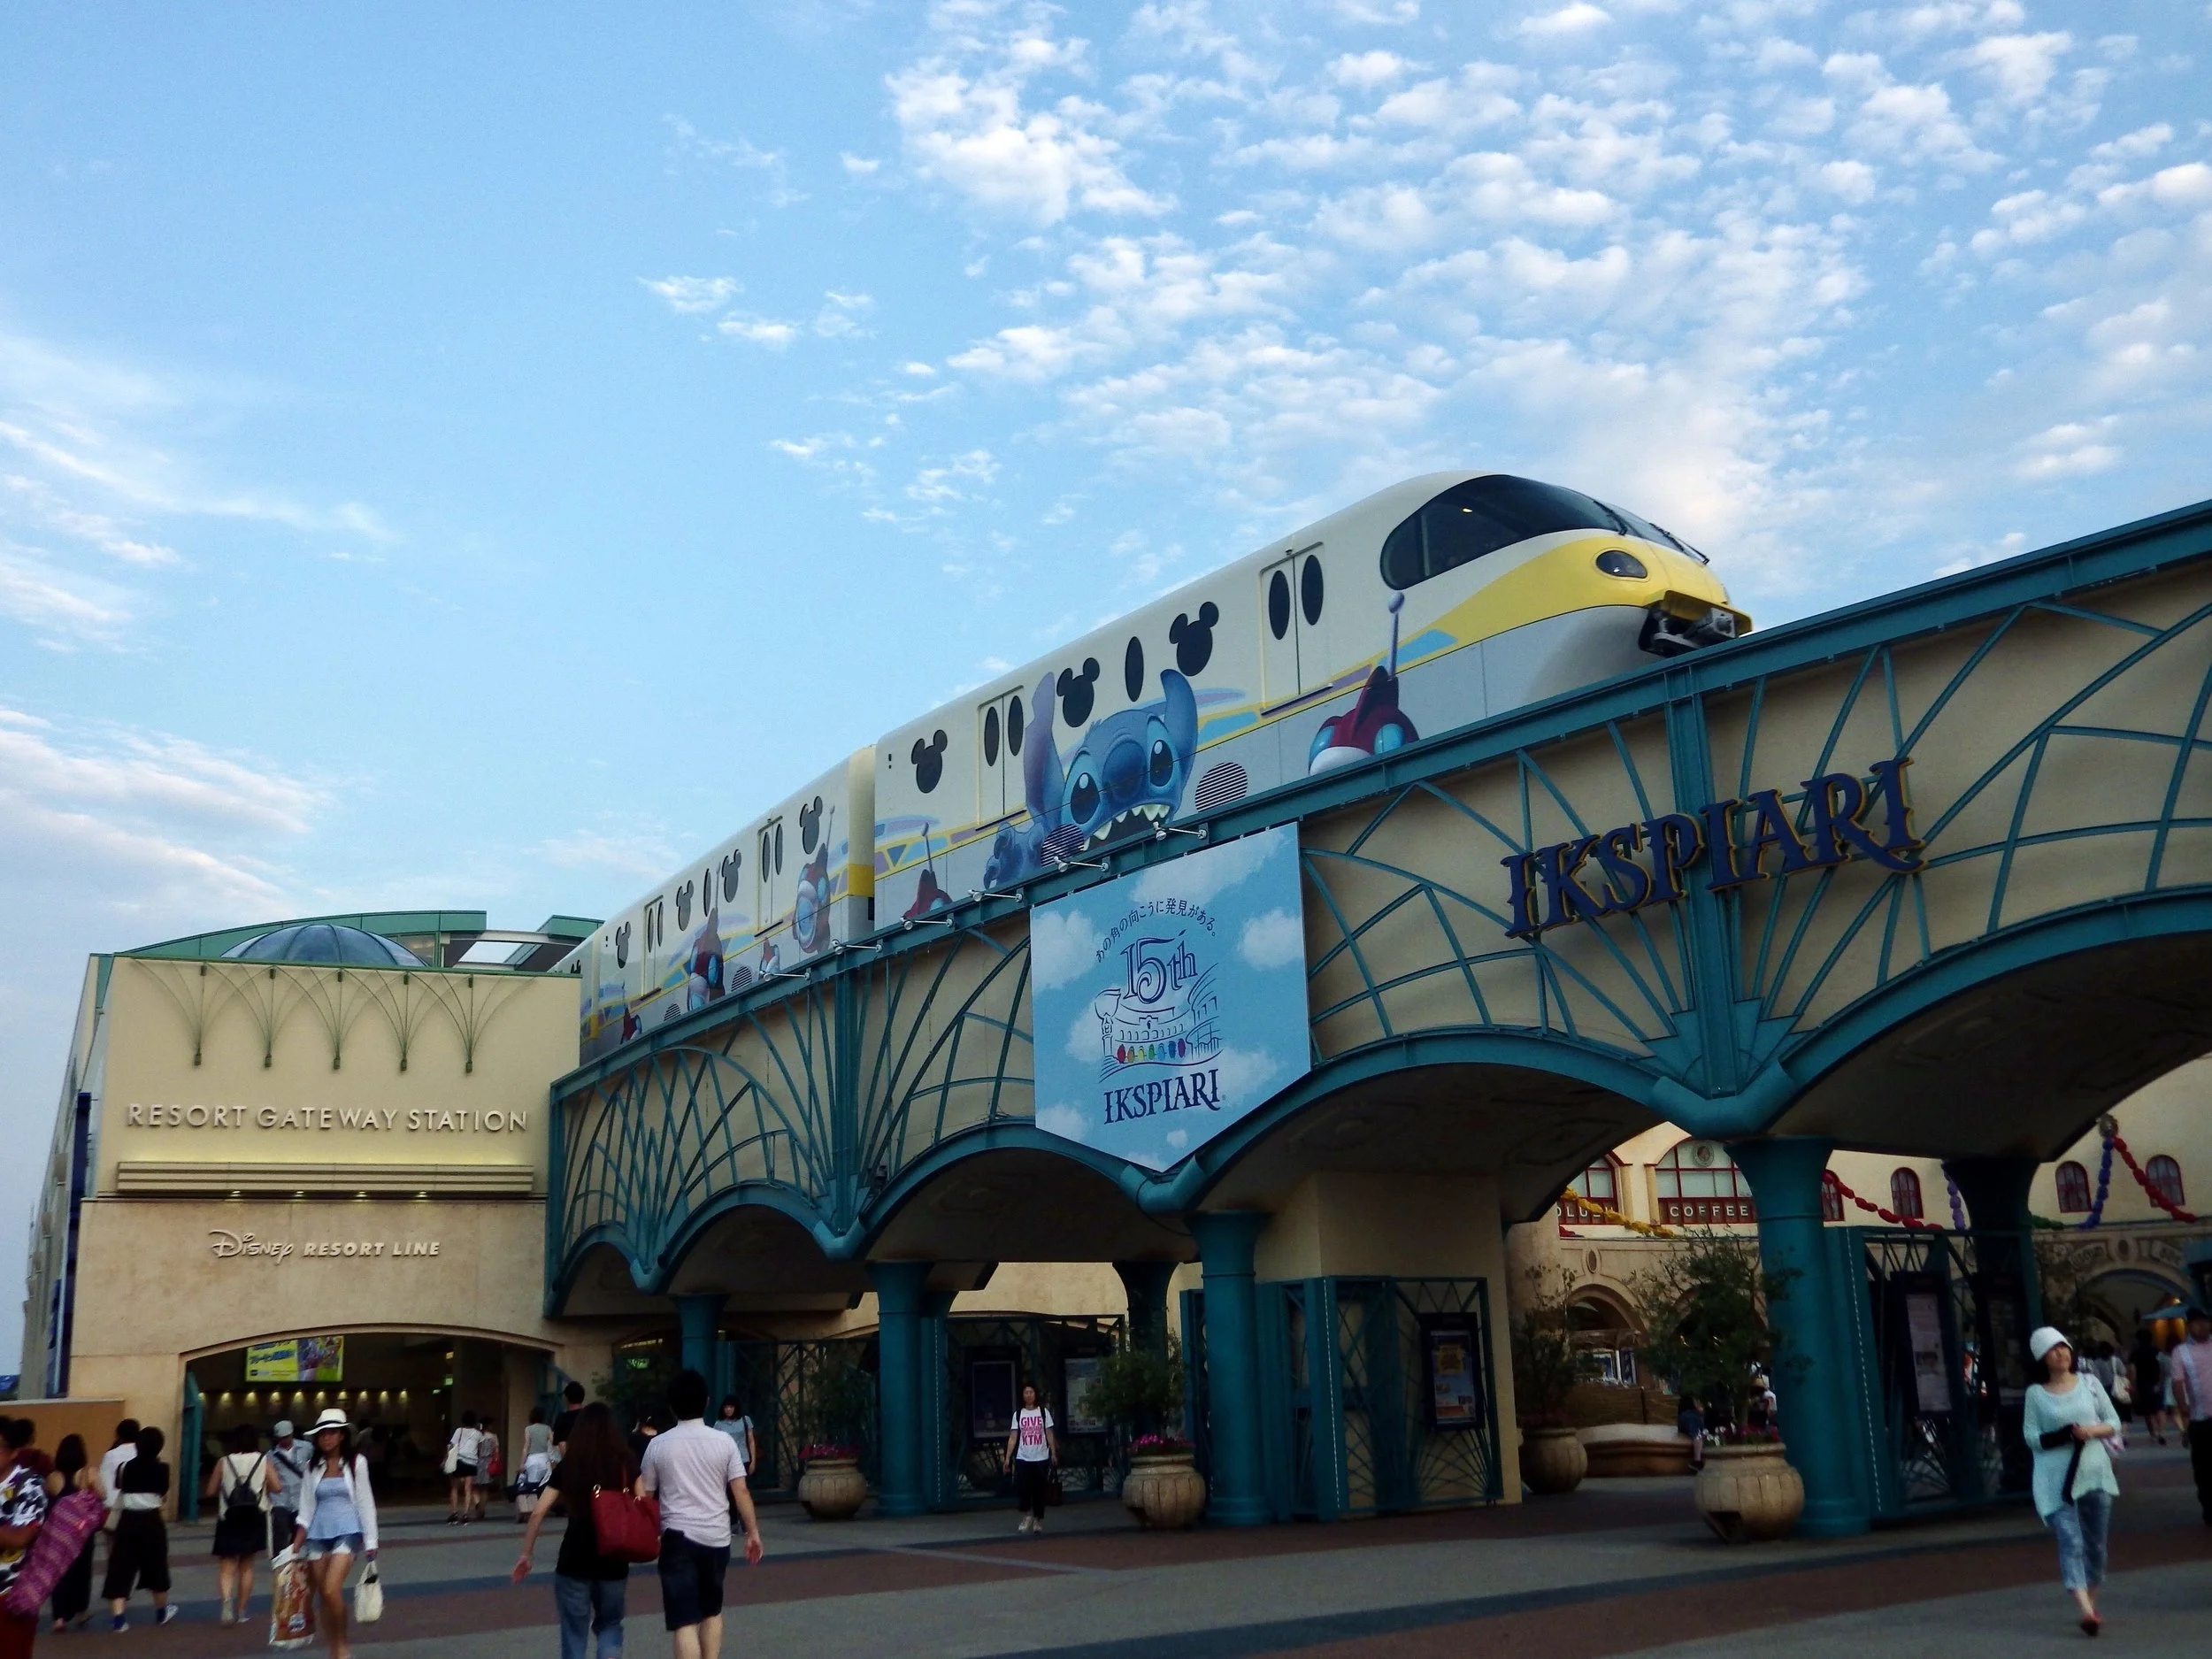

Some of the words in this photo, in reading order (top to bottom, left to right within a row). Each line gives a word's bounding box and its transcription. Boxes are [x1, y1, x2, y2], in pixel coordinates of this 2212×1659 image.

[1500, 757, 1927, 940] IKSPIARI
[1095, 897, 1216, 964] あの角の向こうに発見がある。
[1120, 929, 1198, 1004] 15th
[127, 1102, 247, 1128] RESORT
[257, 1106, 401, 1131] GATEWAY
[407, 1108, 529, 1133] STATION
[1103, 1068, 1221, 1125] IKSPIARI
[1669, 1205, 1749, 1217] COFFEE
[303, 1241, 385, 1257] RESORT
[391, 1241, 441, 1257] LINE
[1021, 1416, 1042, 1427] GIVE
